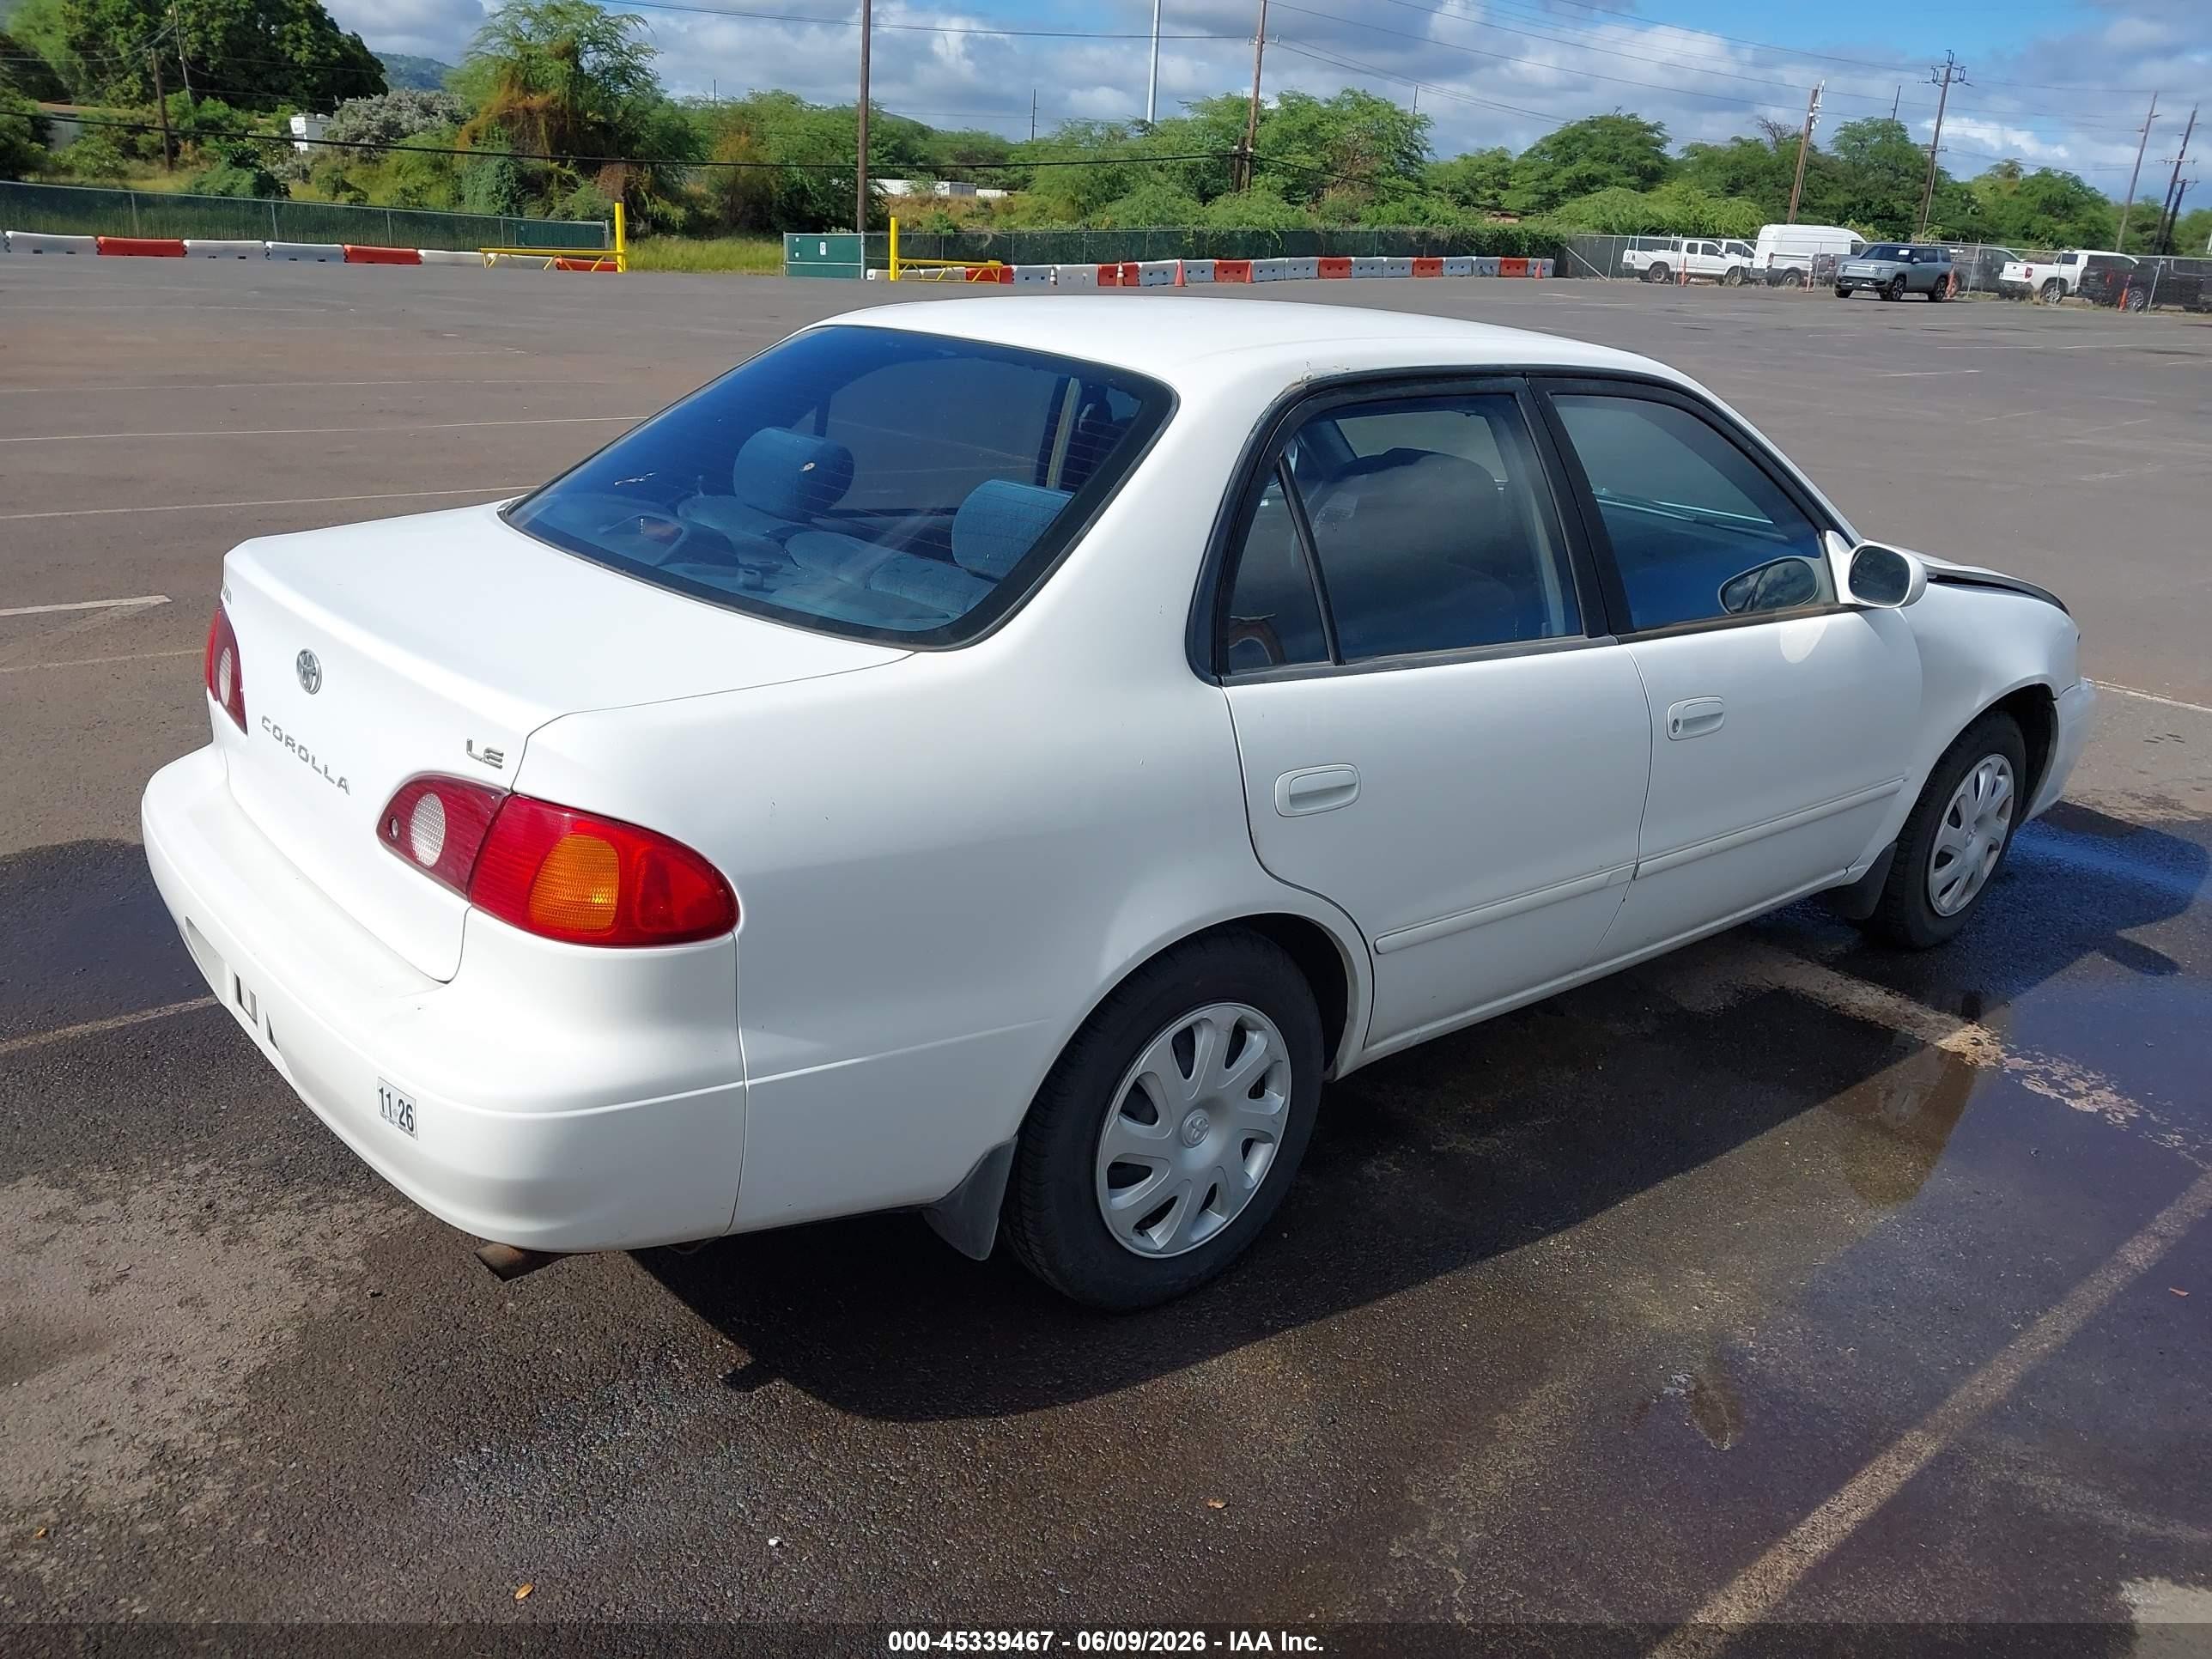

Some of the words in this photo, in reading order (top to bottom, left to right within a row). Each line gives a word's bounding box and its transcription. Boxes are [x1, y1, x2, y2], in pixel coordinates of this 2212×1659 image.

[260, 714, 351, 796] COROLLA
[465, 738, 505, 769] LE
[378, 1086, 392, 1119] 11
[398, 1098, 415, 1133] 26
